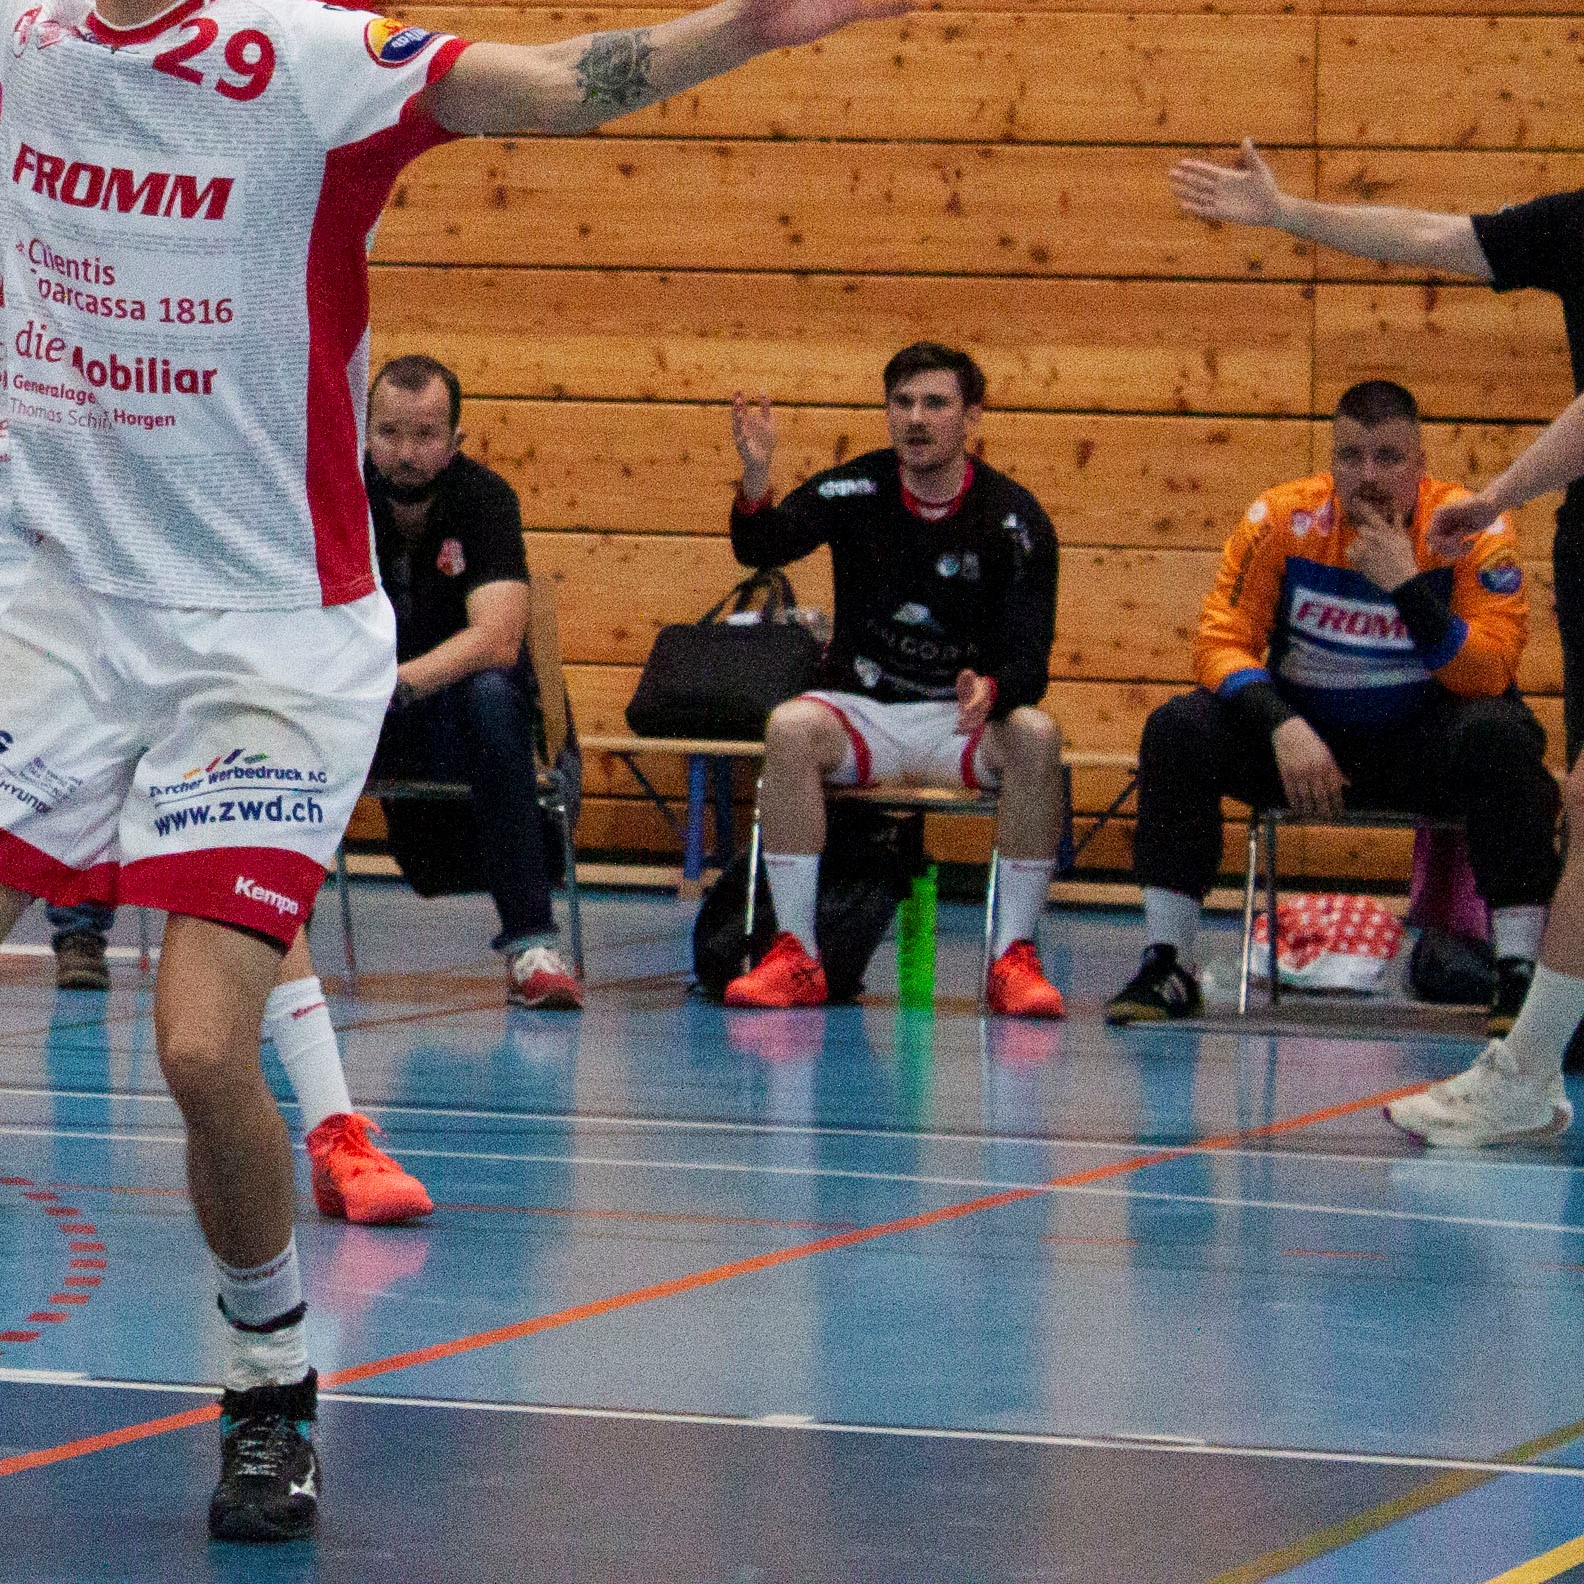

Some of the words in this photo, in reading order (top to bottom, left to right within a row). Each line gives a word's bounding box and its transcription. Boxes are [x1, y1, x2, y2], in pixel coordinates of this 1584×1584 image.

[152, 16, 279, 103] 29
[13, 141, 236, 222] FROMM
[27, 236, 117, 288] Clientis
[29, 267, 148, 323] parcassa
[158, 297, 235, 325] 1816
[14, 319, 67, 365] die
[12, 372, 97, 407] Generalage
[112, 408, 177, 431] Horgen
[1296, 601, 1412, 639] FROM
[206, 766, 305, 785] Werbedruck
[307, 770, 329, 784] AG
[153, 794, 325, 838] www.zwd.ch
[233, 874, 301, 917] Kempa
